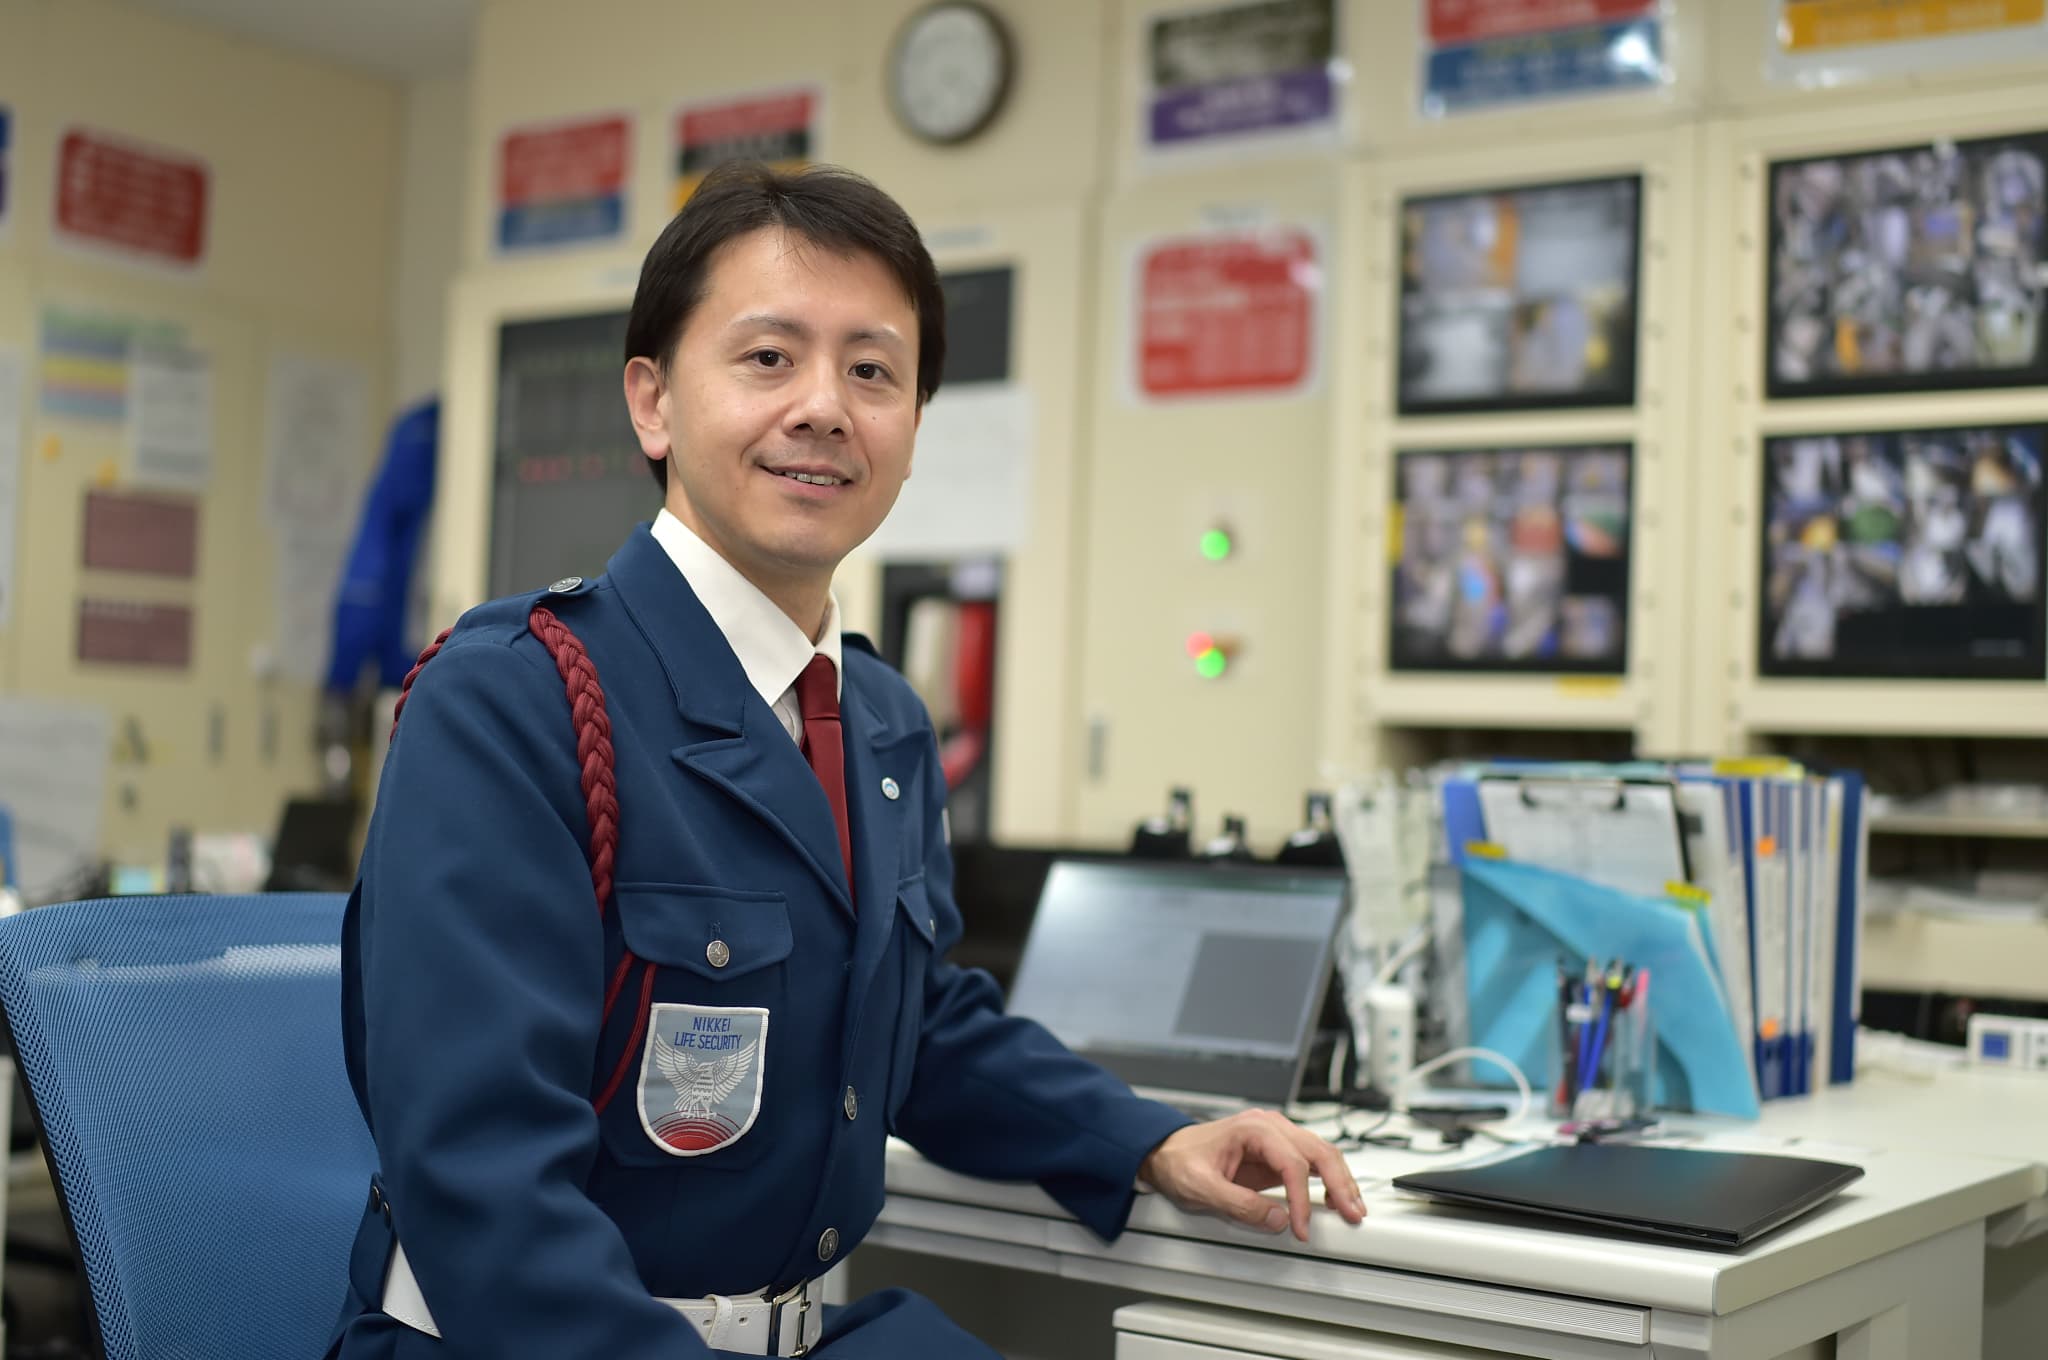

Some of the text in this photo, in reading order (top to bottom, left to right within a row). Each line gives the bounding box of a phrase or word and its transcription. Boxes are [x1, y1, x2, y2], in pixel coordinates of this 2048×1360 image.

[693, 1017, 731, 1032] NIKKEI
[674, 1032, 742, 1050] LIFE SECURITY
